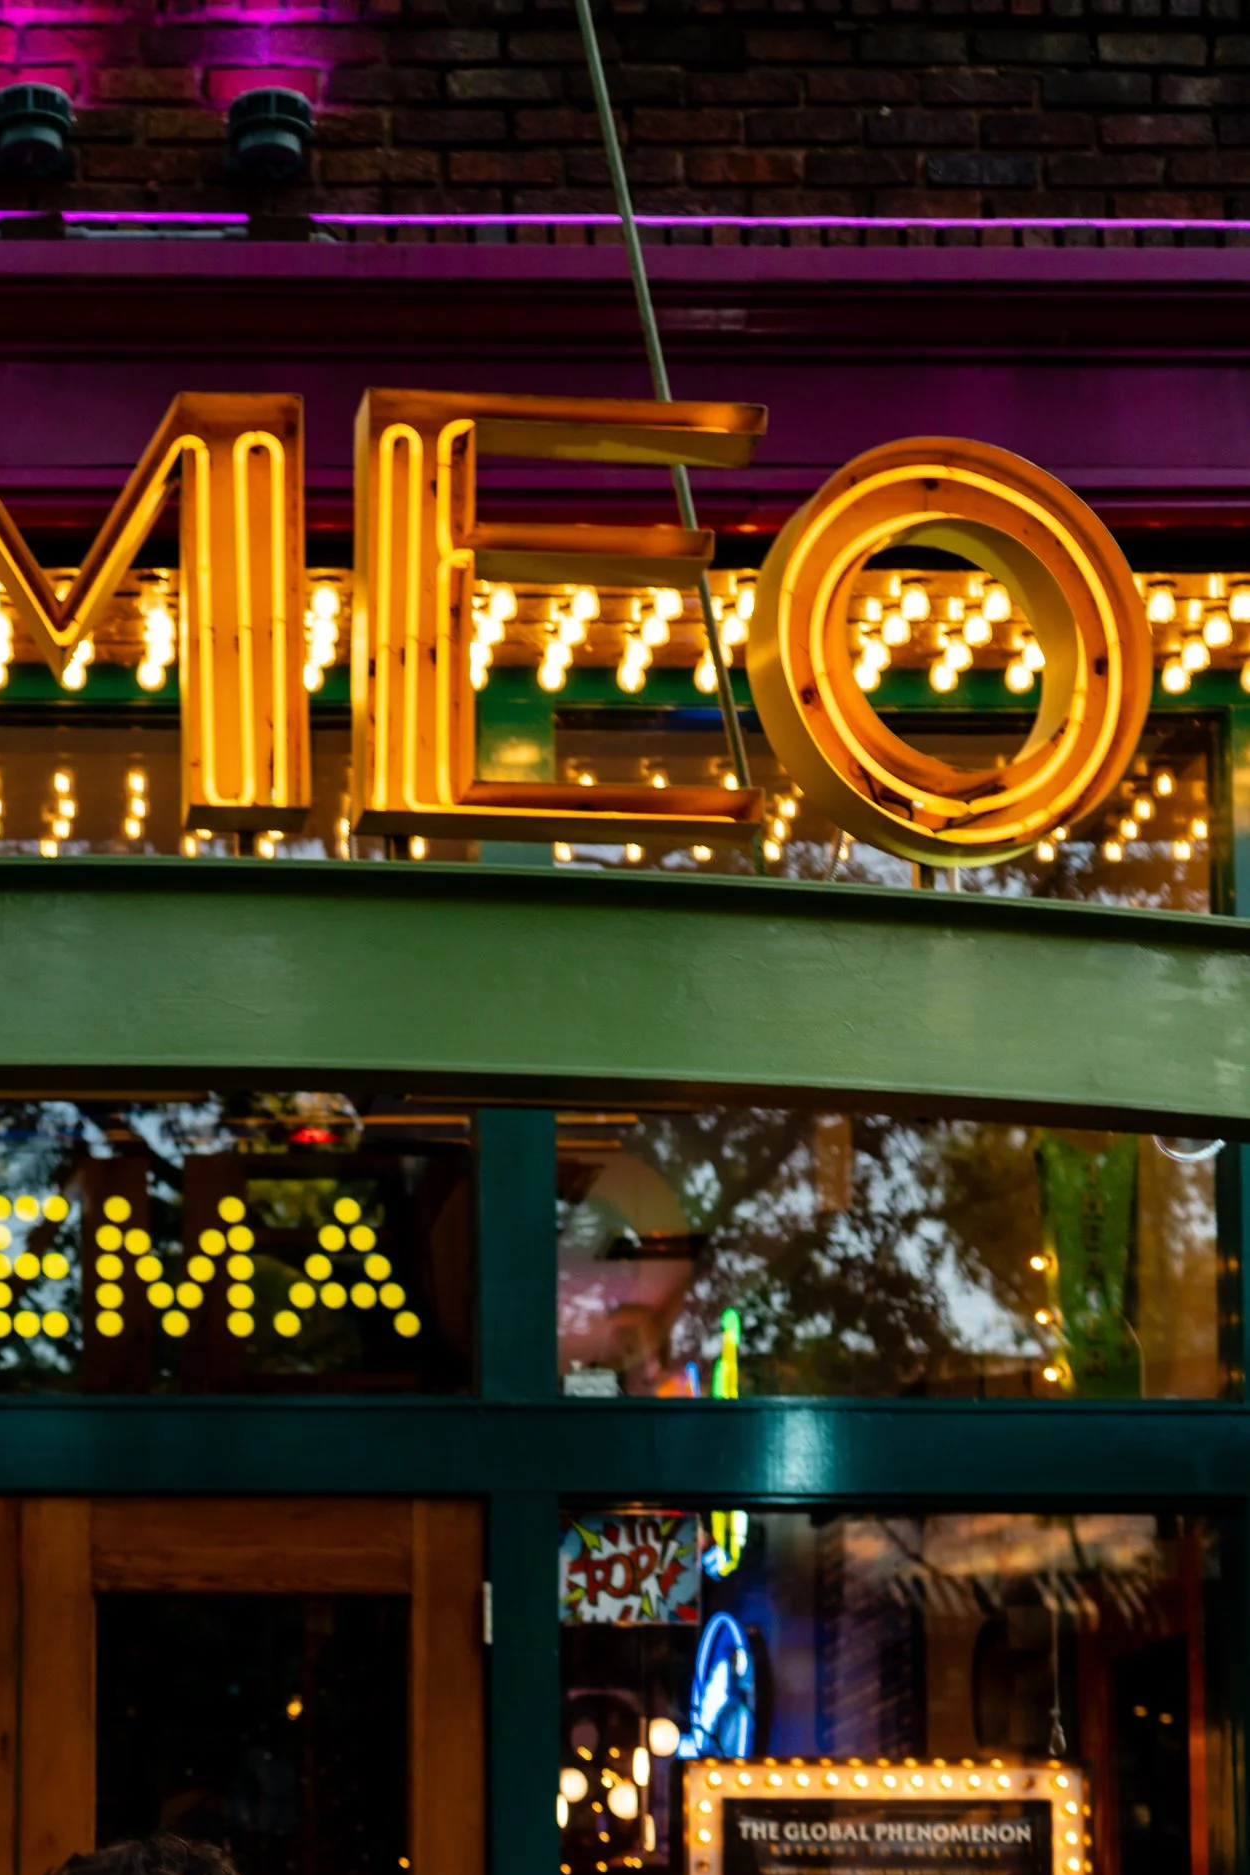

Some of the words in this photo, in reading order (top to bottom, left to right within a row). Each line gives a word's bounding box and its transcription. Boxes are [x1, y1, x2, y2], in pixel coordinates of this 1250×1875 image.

[738, 1820, 779, 1841] THE
[783, 1821, 871, 1842] GLOBAL
[875, 1823, 1032, 1843] PHENOMENON
